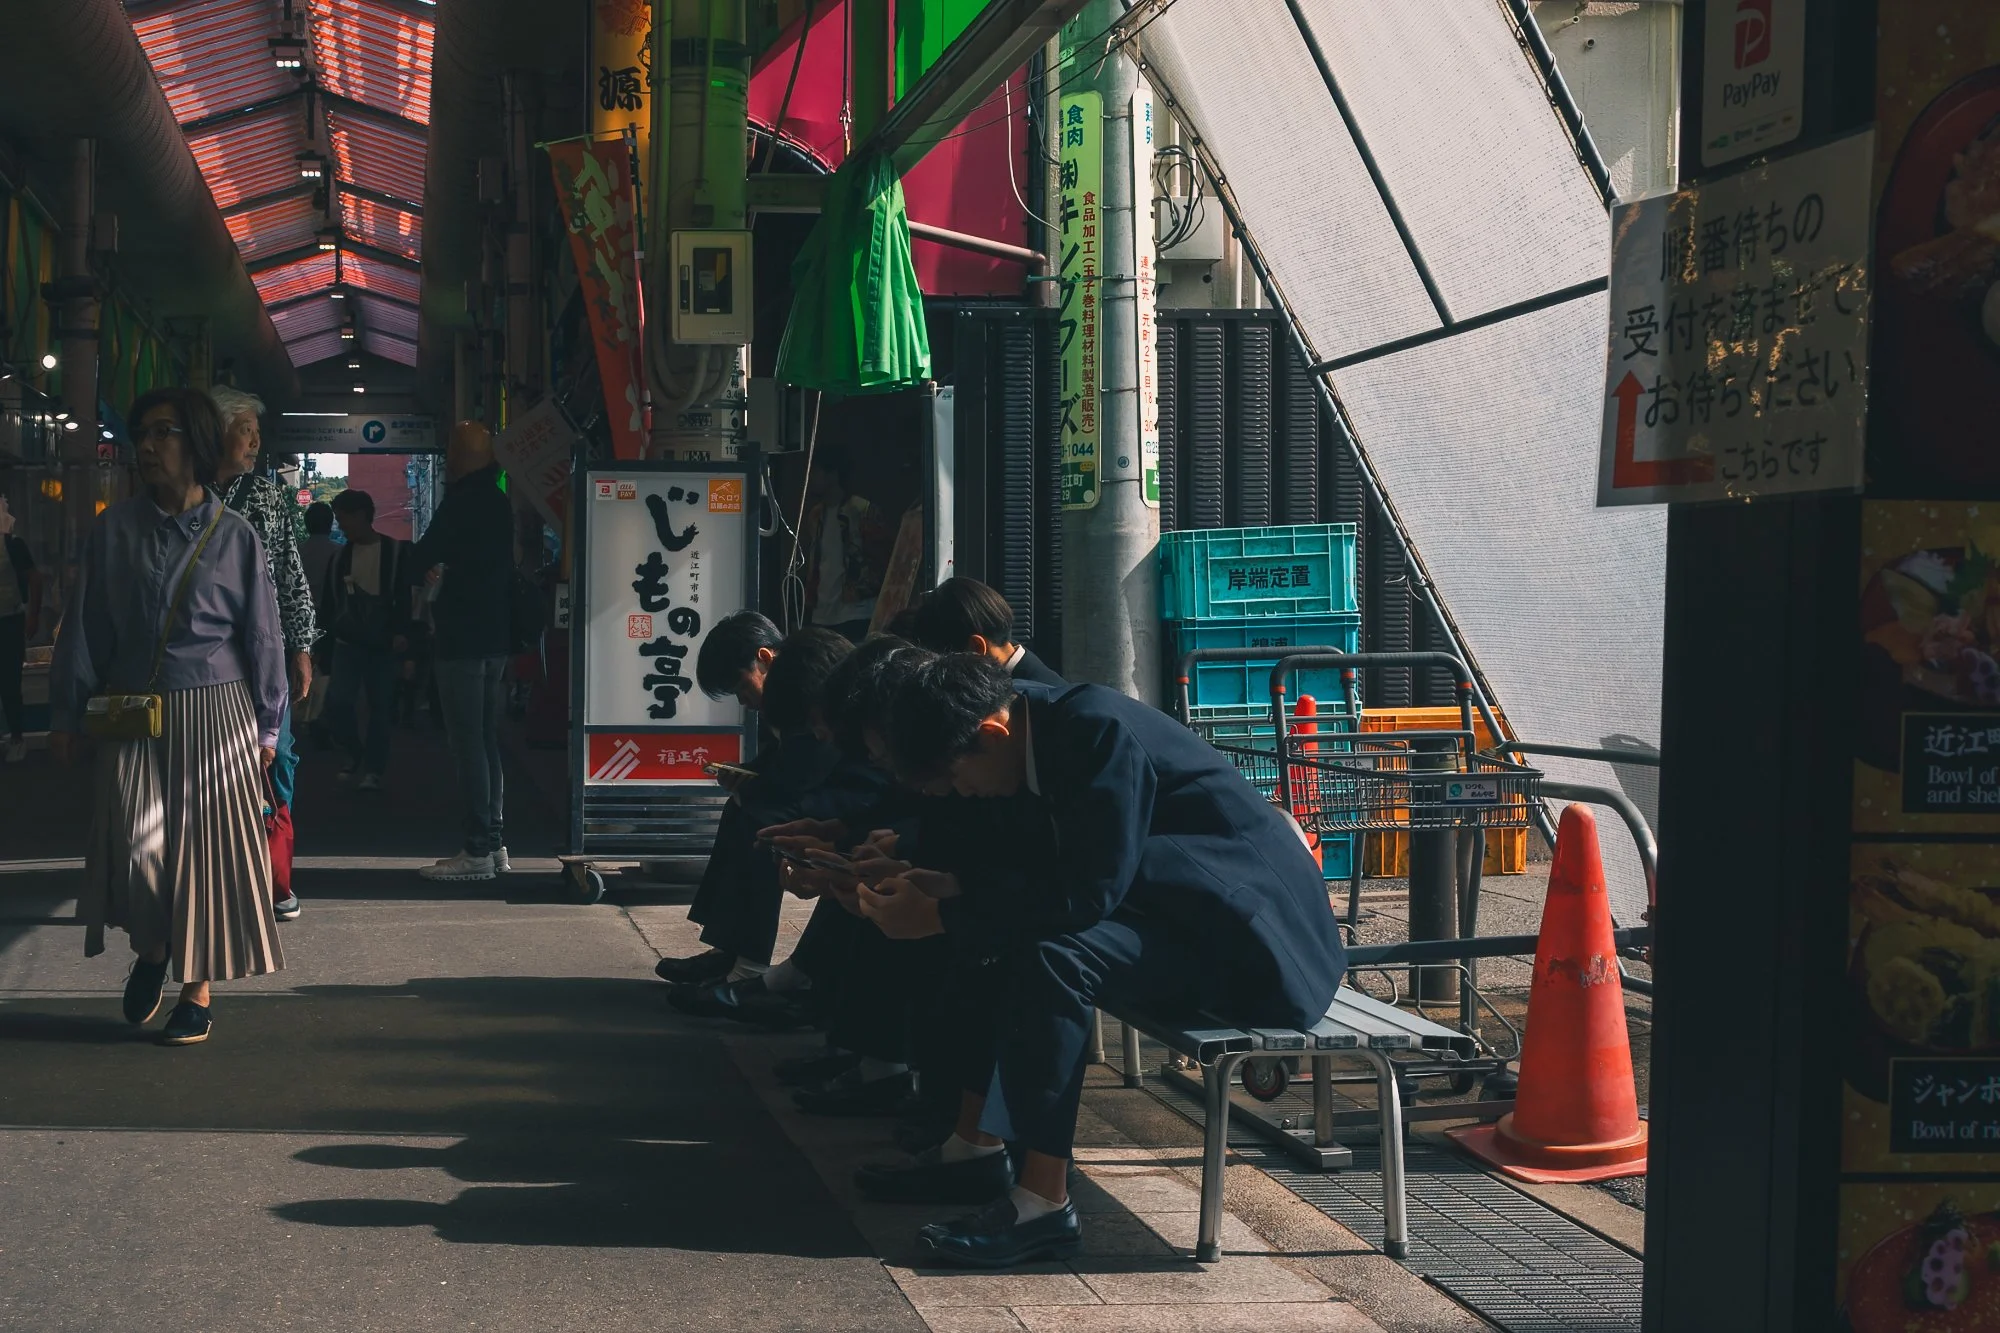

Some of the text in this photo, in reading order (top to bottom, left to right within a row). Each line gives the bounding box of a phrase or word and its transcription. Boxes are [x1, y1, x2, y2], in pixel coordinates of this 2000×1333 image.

[1722, 70, 1781, 108] PayPay
[1067, 104, 1084, 148] 食肉
[1660, 193, 1824, 282] 順番待ちの
[1623, 263, 1854, 361] 受付を済ませて
[1644, 350, 1856, 428] お待ちください
[1721, 431, 1829, 481] こちらです
[710, 492, 740, 502] 食べログ
[690, 550, 700, 603] 近江町市場
[1227, 565, 1311, 591] 岸端定置
[632, 486, 701, 719] じもの亭
[656, 746, 709, 766] 福正宗
[1928, 765, 1999, 784] Bowl of
[1927, 785, 1961, 803] and
[1911, 1120, 1956, 1139] Bowl
[1960, 1120, 1979, 1139] of
